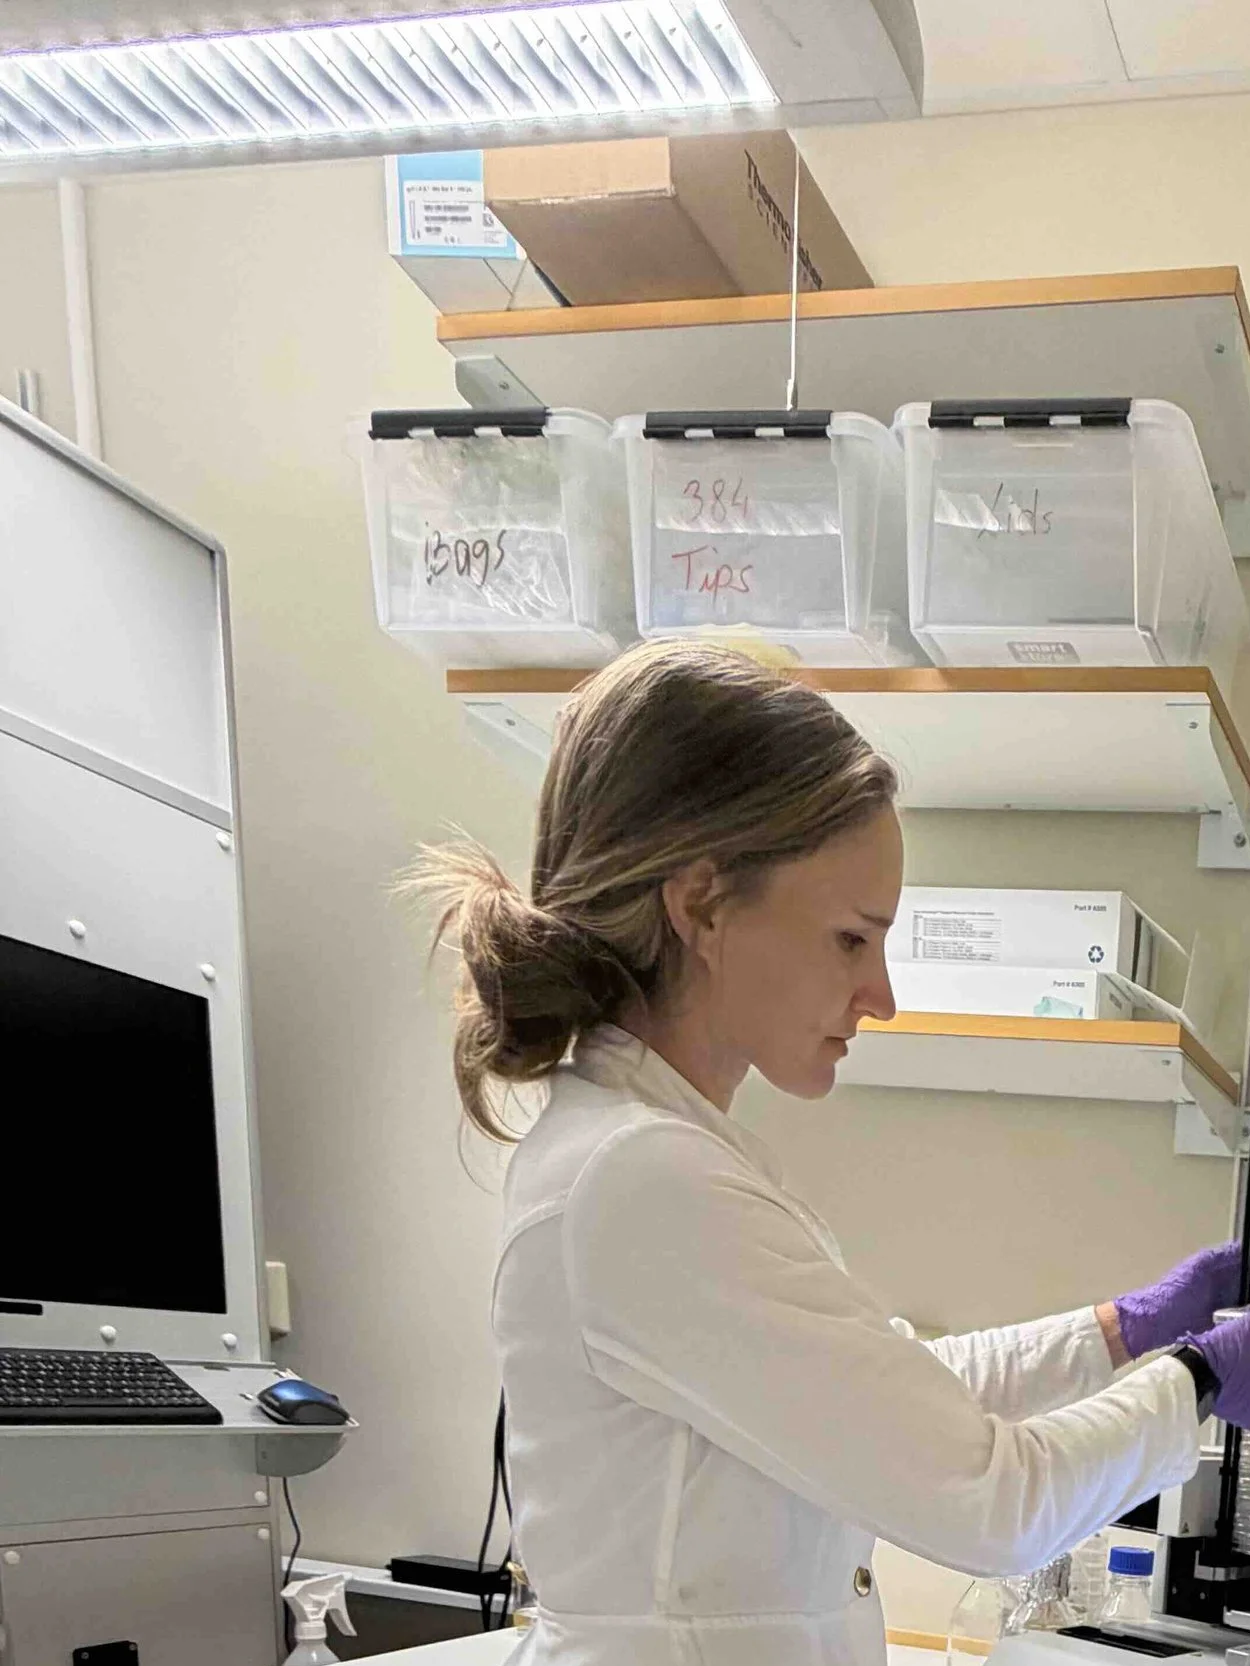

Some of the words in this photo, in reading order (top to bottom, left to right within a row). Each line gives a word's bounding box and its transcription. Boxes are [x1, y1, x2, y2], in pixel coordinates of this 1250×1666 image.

[744, 148, 791, 240] Thermo
[683, 479, 749, 523] 384
[671, 544, 753, 603] Tips
